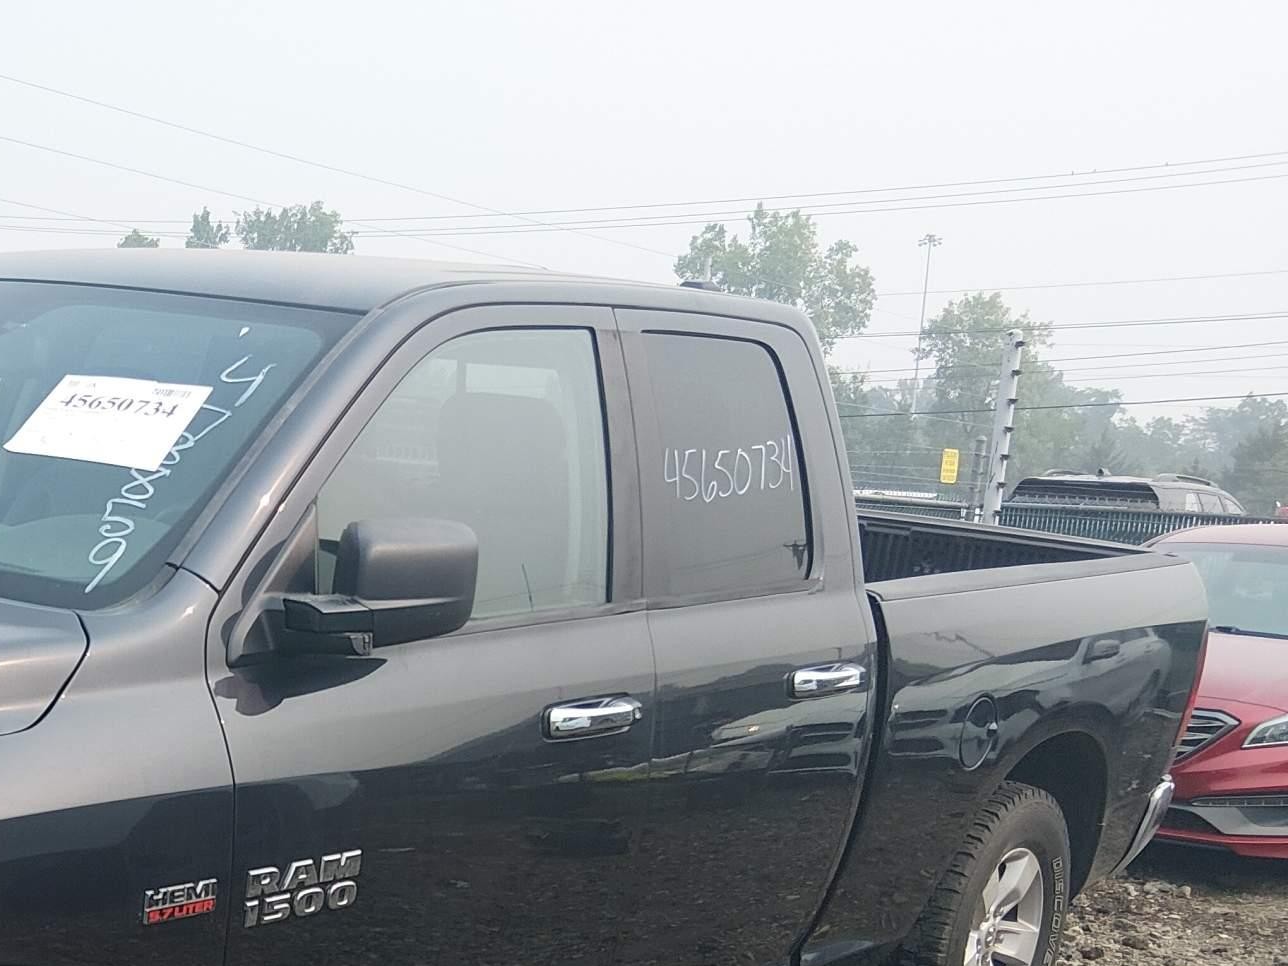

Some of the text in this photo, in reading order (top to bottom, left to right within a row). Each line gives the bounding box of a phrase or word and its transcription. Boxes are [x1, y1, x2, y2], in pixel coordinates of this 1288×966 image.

[59, 392, 179, 418] 45650734
[664, 434, 794, 502] 45650734
[246, 849, 362, 898] RAM
[144, 878, 218, 909] HEMI
[174, 899, 216, 918] LITER
[244, 880, 358, 928] 1500
